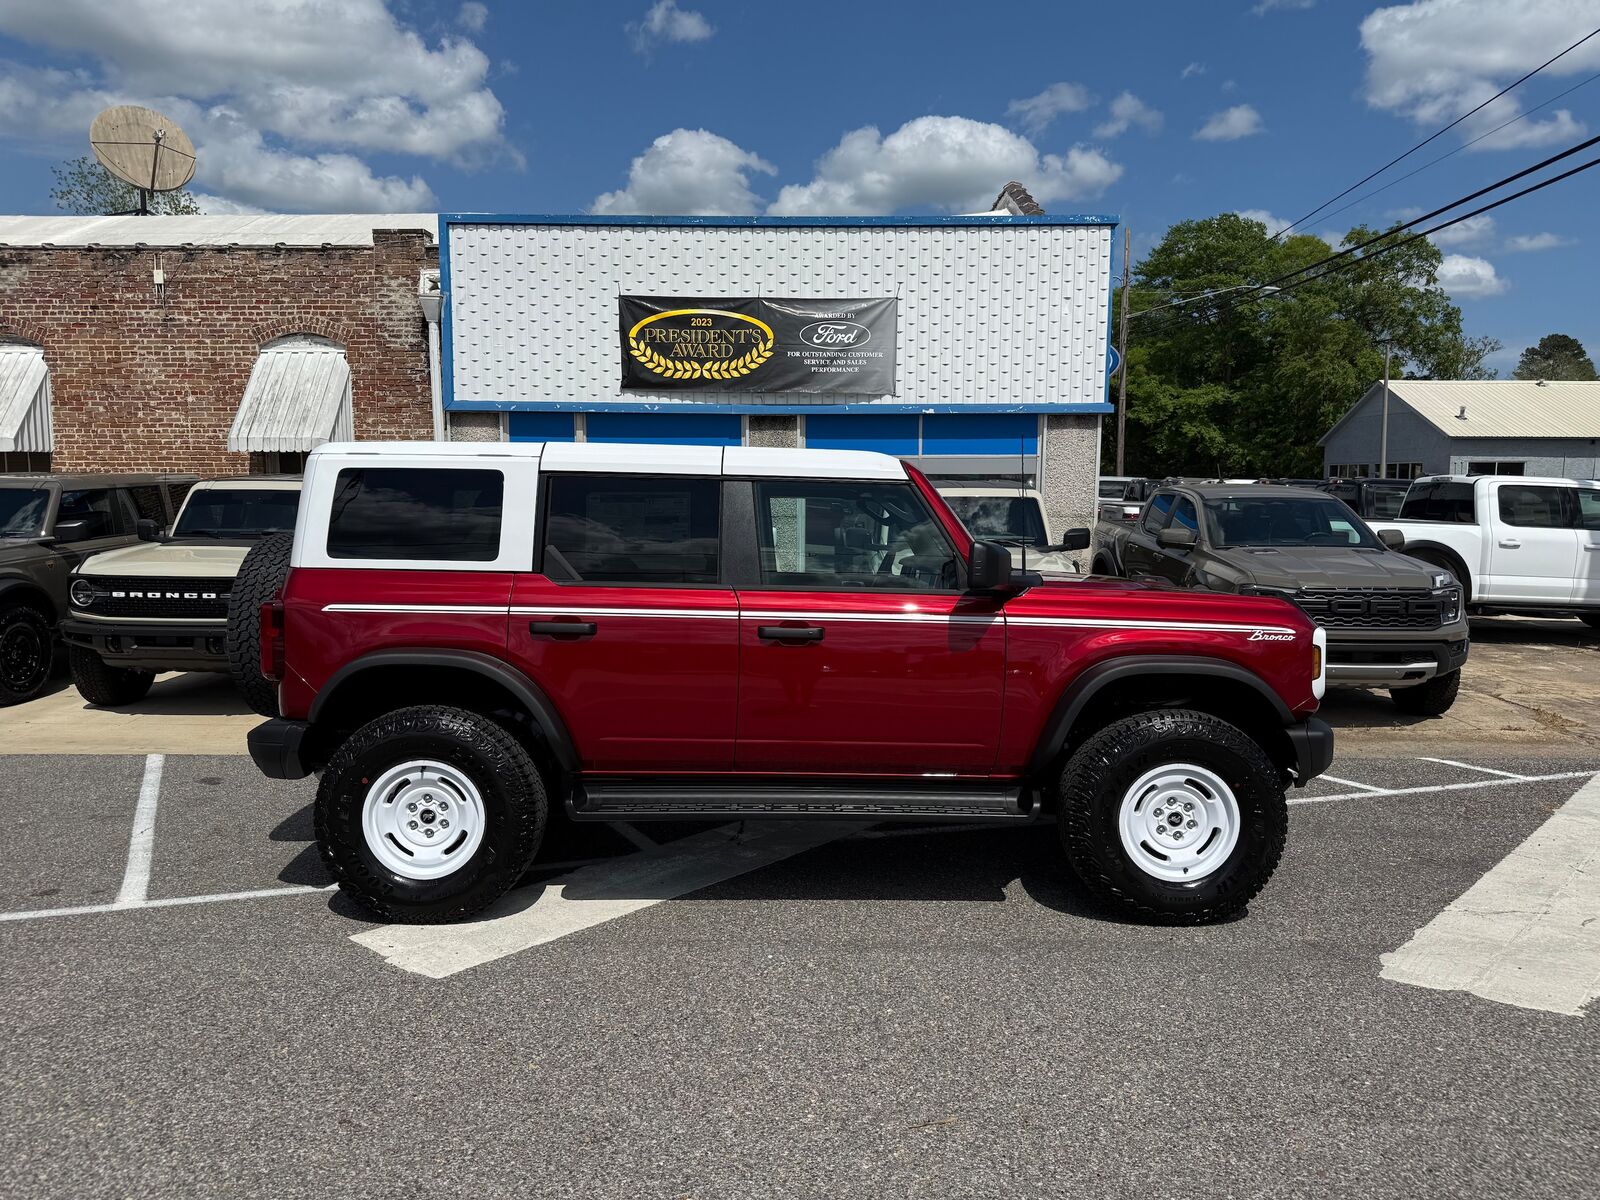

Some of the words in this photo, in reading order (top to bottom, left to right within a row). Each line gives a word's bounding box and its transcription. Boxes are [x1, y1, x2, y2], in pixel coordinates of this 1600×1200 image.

[691, 318, 712, 326] 2023
[644, 328, 761, 343] PRESIDENT'S
[813, 324, 858, 343] Ford
[669, 343, 734, 358] AWARD
[112, 591, 217, 599] BRONCO
[1246, 629, 1296, 641] Bronco
